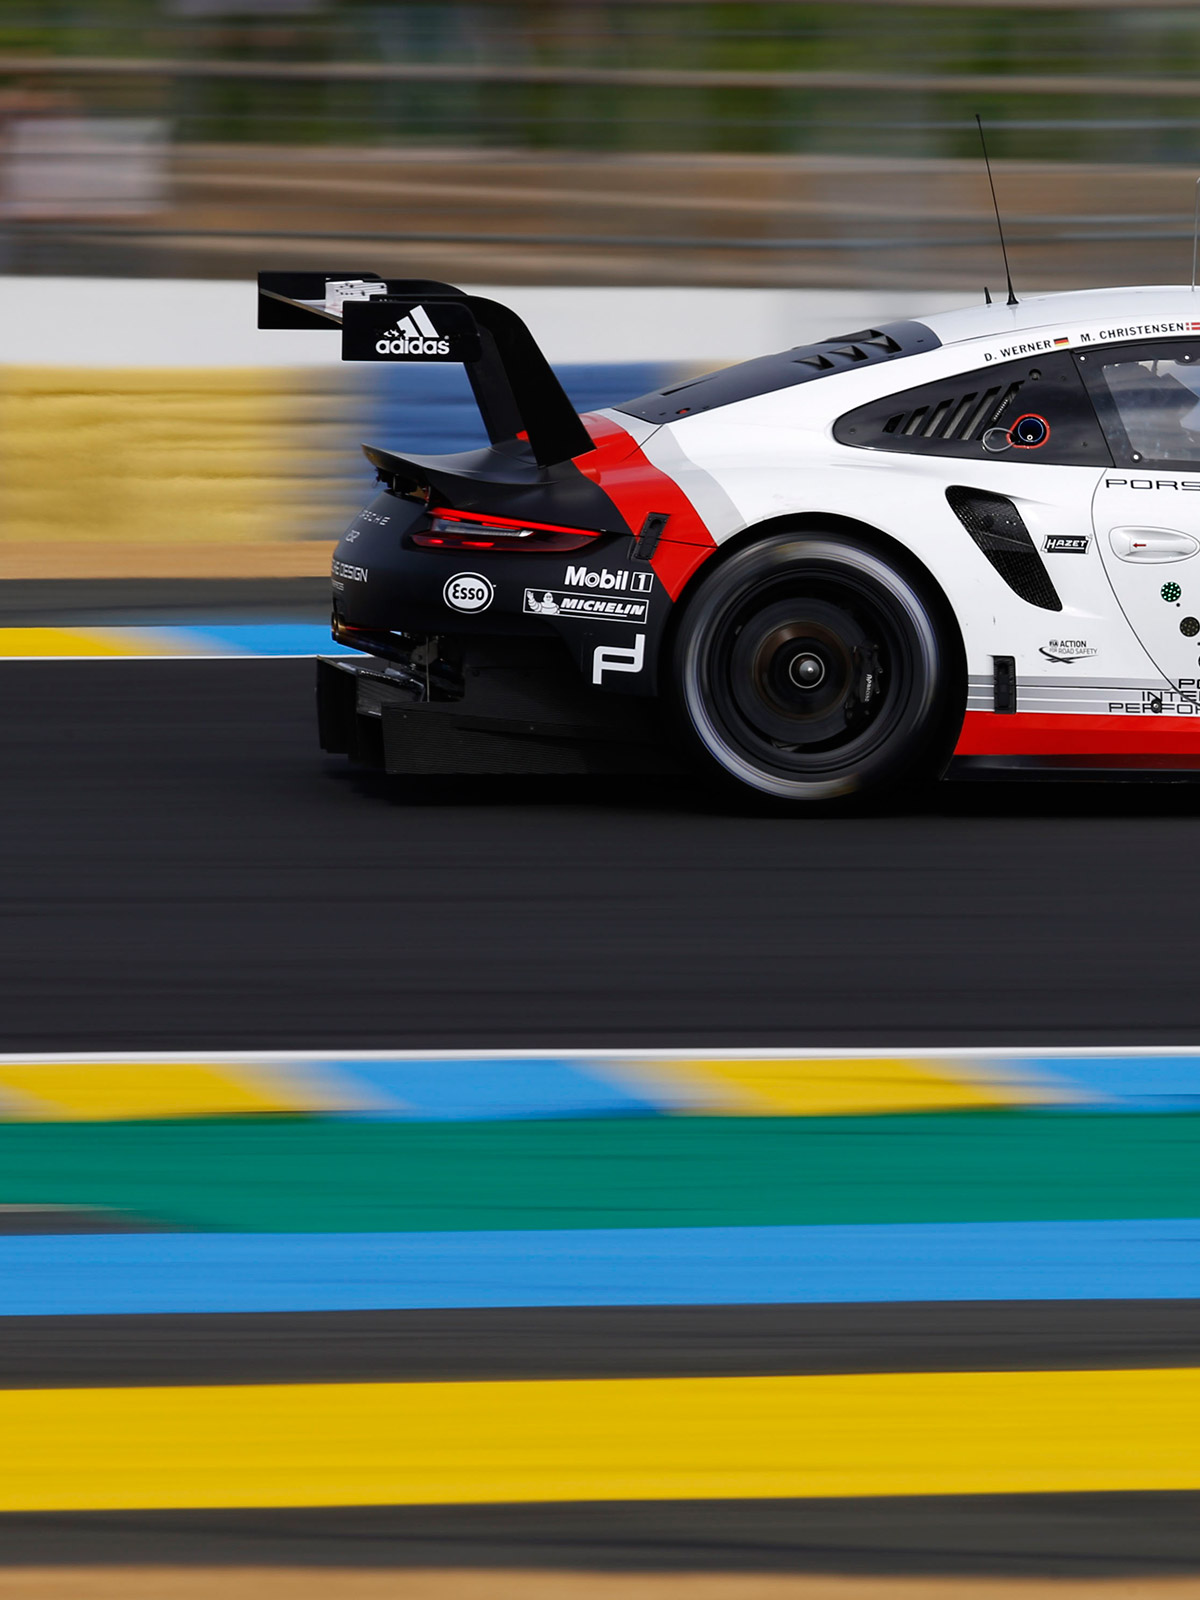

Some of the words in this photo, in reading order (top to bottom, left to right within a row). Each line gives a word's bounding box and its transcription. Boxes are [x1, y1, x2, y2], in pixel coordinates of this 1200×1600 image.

[1080, 332, 1097, 343] M.
[1099, 322, 1184, 340] CHRISTENSEN
[375, 336, 451, 355] adidas
[984, 352, 998, 362] D.
[1000, 339, 1051, 358] WERNER
[1046, 538, 1087, 549] HAZET
[565, 565, 629, 590] Mobil
[452, 583, 485, 601] Esso
[560, 597, 645, 616] MICHELIN
[1060, 640, 1087, 648] ACTION
